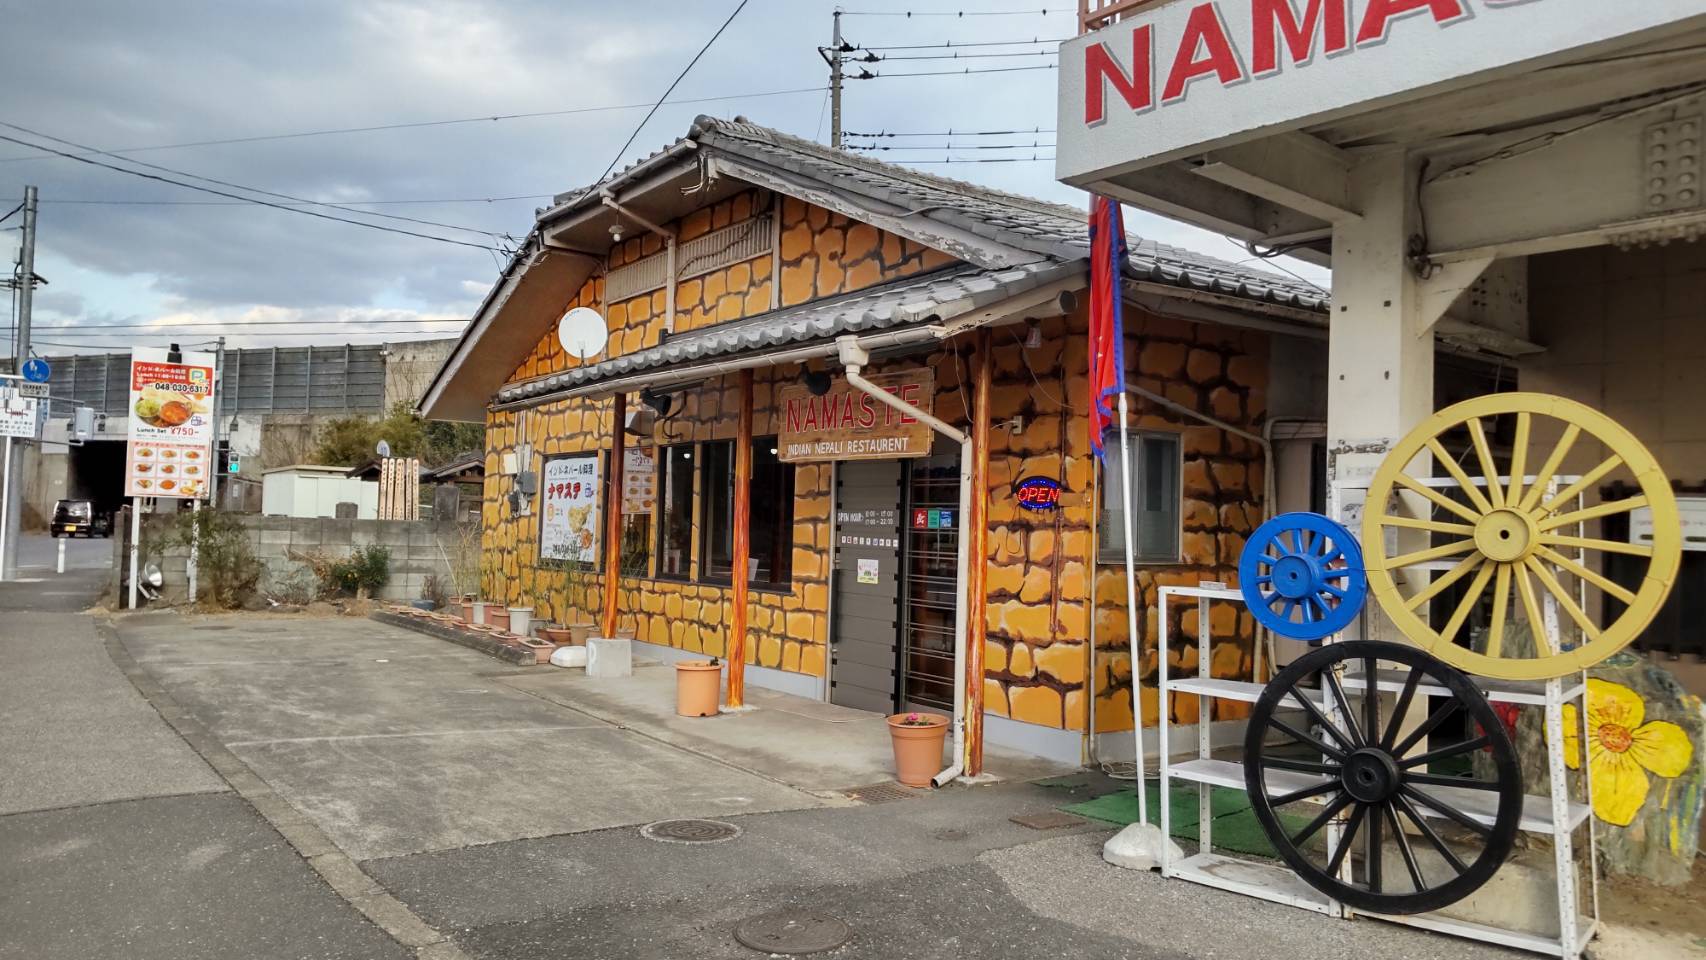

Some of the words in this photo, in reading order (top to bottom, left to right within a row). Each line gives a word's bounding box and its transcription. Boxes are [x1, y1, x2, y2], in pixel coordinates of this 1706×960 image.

[785, 384, 920, 433] NAMASTE
[787, 443, 811, 455] INDIAN
[815, 443, 843, 454] NEPALI
[847, 437, 909, 453] RESTAURENT
[548, 482, 581, 500] ナマステ
[1018, 487, 1060, 502] OPEN
